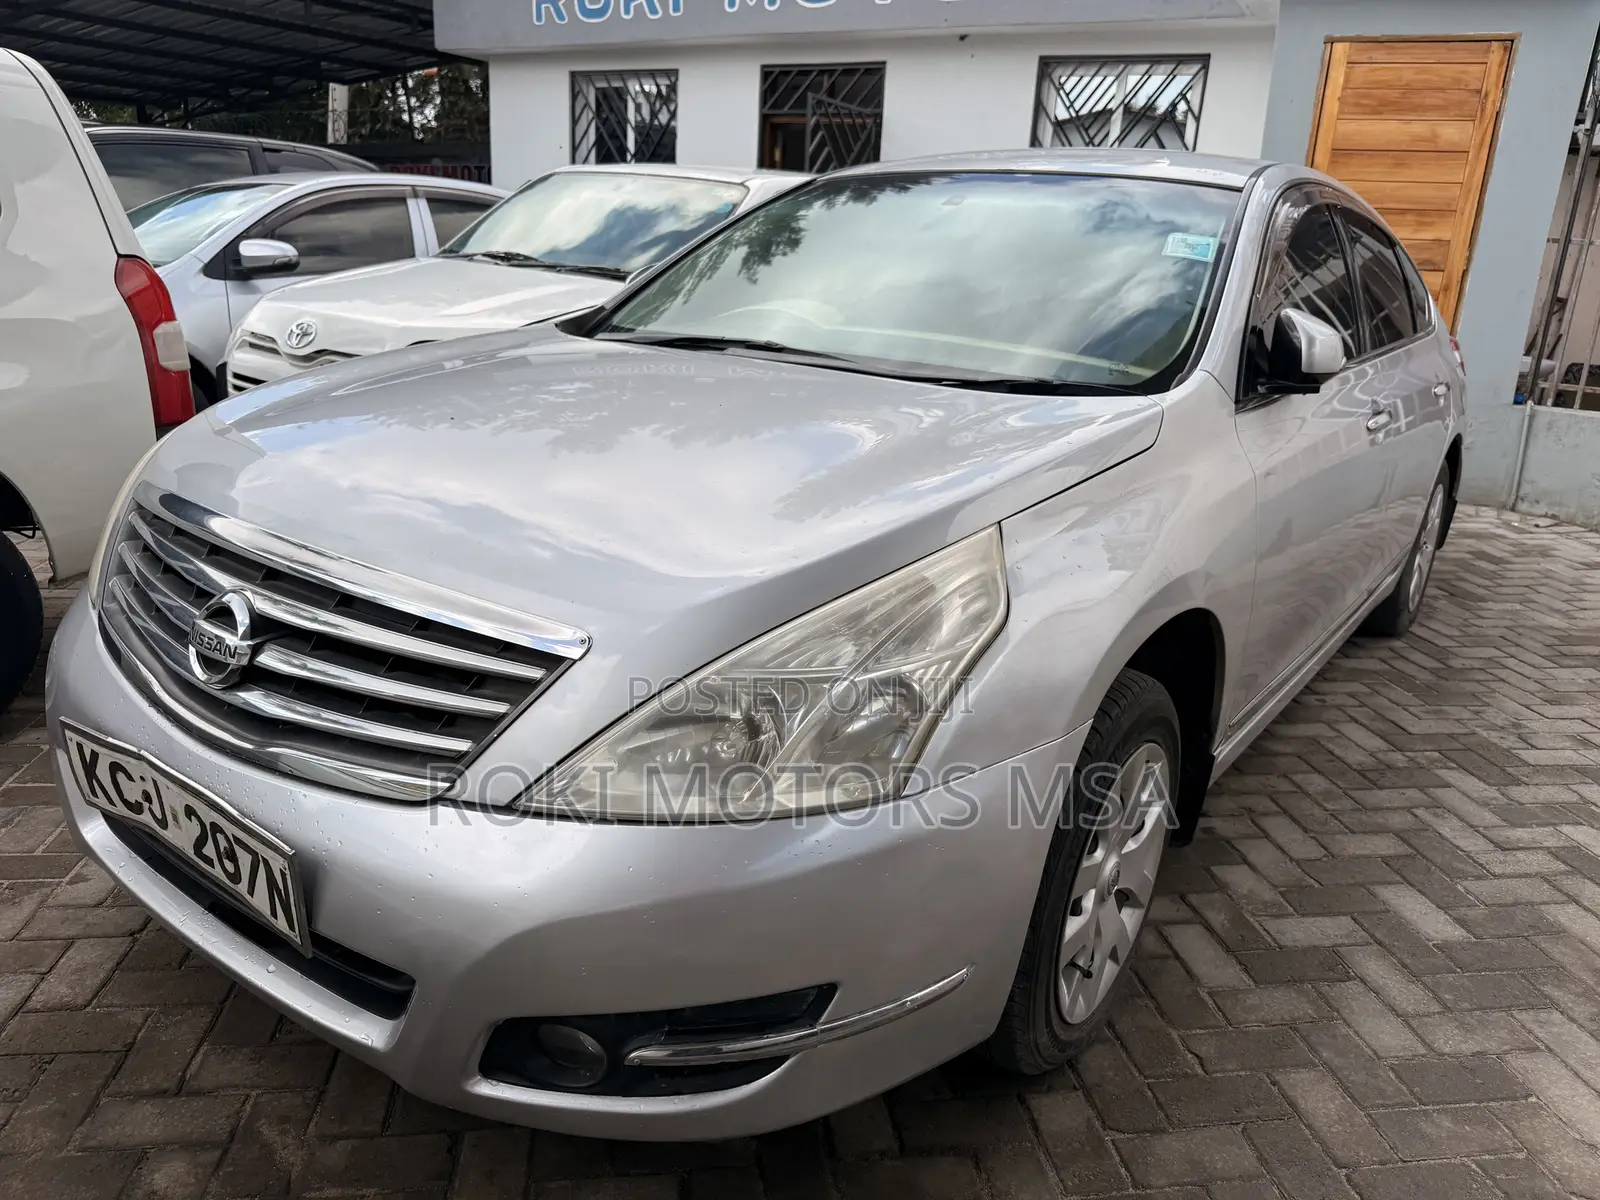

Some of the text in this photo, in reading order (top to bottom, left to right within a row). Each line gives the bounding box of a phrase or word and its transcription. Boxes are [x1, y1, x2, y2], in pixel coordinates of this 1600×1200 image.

[189, 620, 238, 660] NISSAN
[76, 740, 297, 934] KCJ 207N
